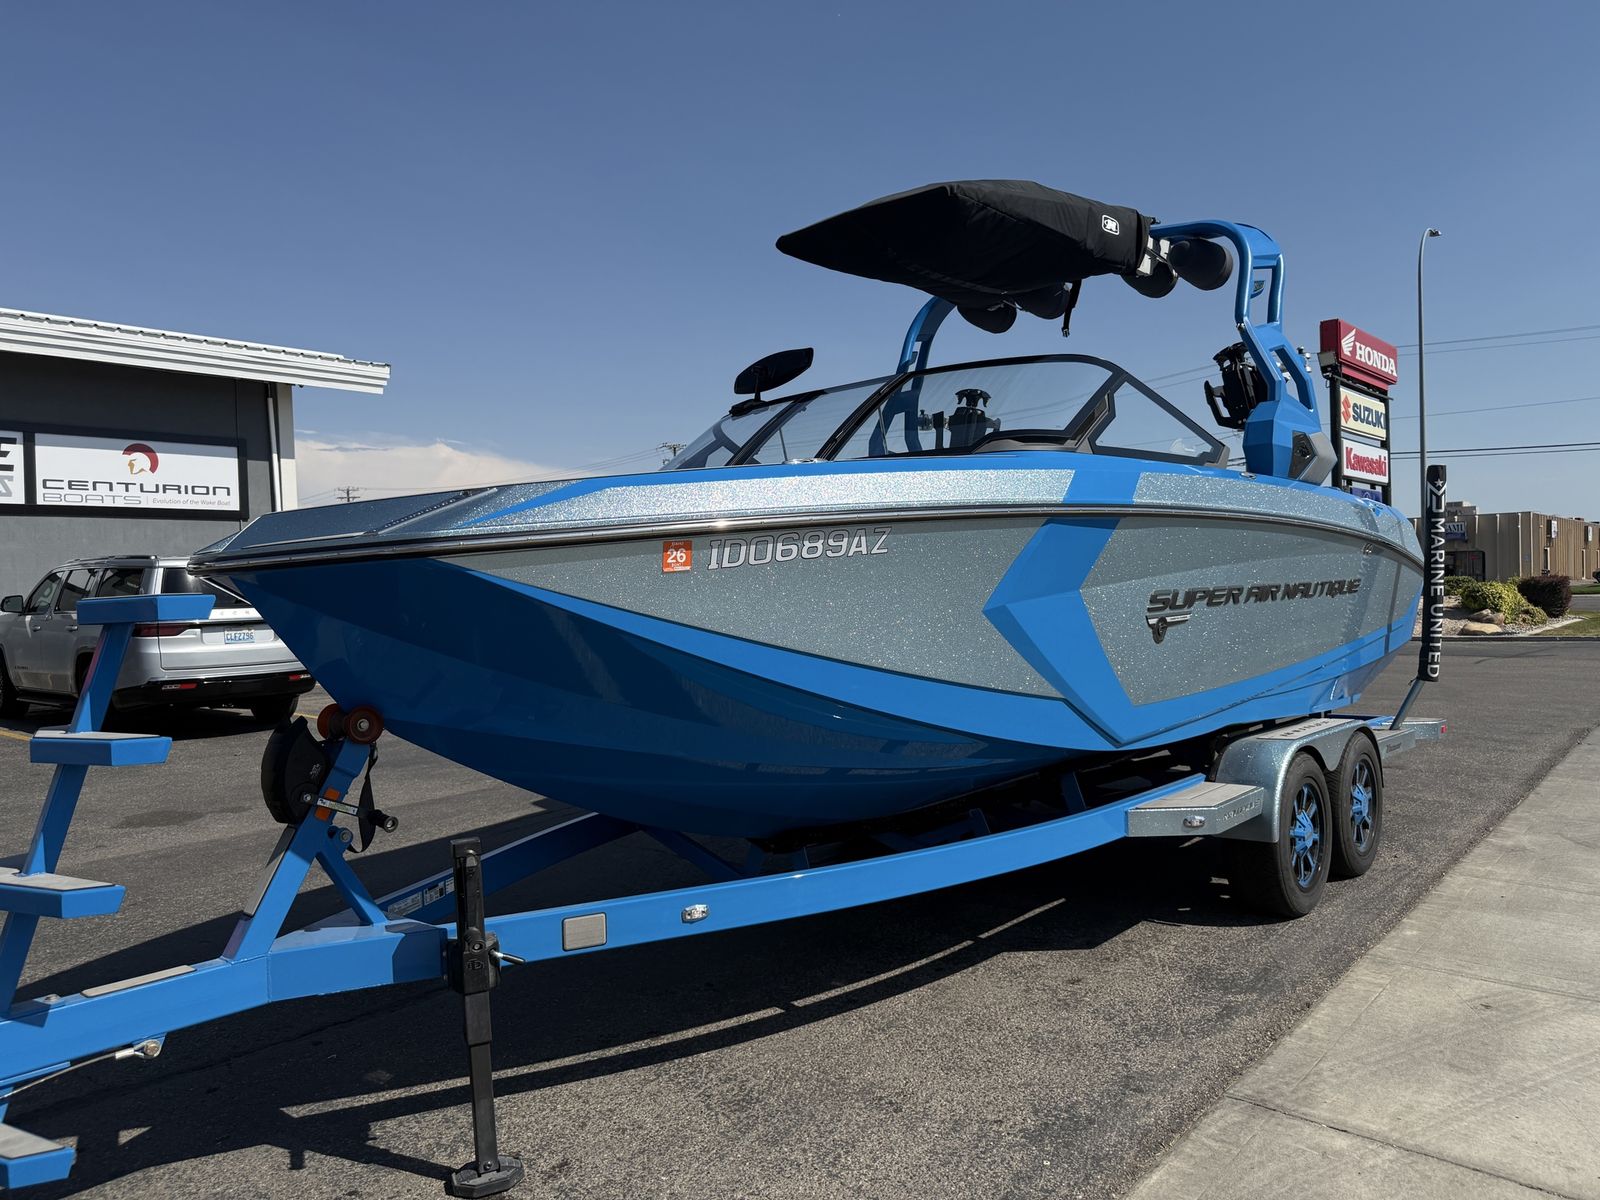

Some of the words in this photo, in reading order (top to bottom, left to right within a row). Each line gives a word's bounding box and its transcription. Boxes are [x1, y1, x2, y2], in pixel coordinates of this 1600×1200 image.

[1355, 341, 1398, 377] HONDA
[1352, 402, 1386, 430] SUZUKI
[1345, 446, 1387, 477] Kawasaki
[42, 478, 231, 496] CENTURION
[42, 492, 142, 505] BOATS
[152, 497, 181, 505] Evolution
[190, 498, 200, 506] the
[667, 548, 687, 564] 26
[1430, 517, 1446, 597] MARINE
[1147, 585, 1244, 613] SUPER
[1243, 583, 1282, 605] AIR
[1281, 578, 1362, 600] NAUTIQUE
[1427, 603, 1444, 679] UNITED
